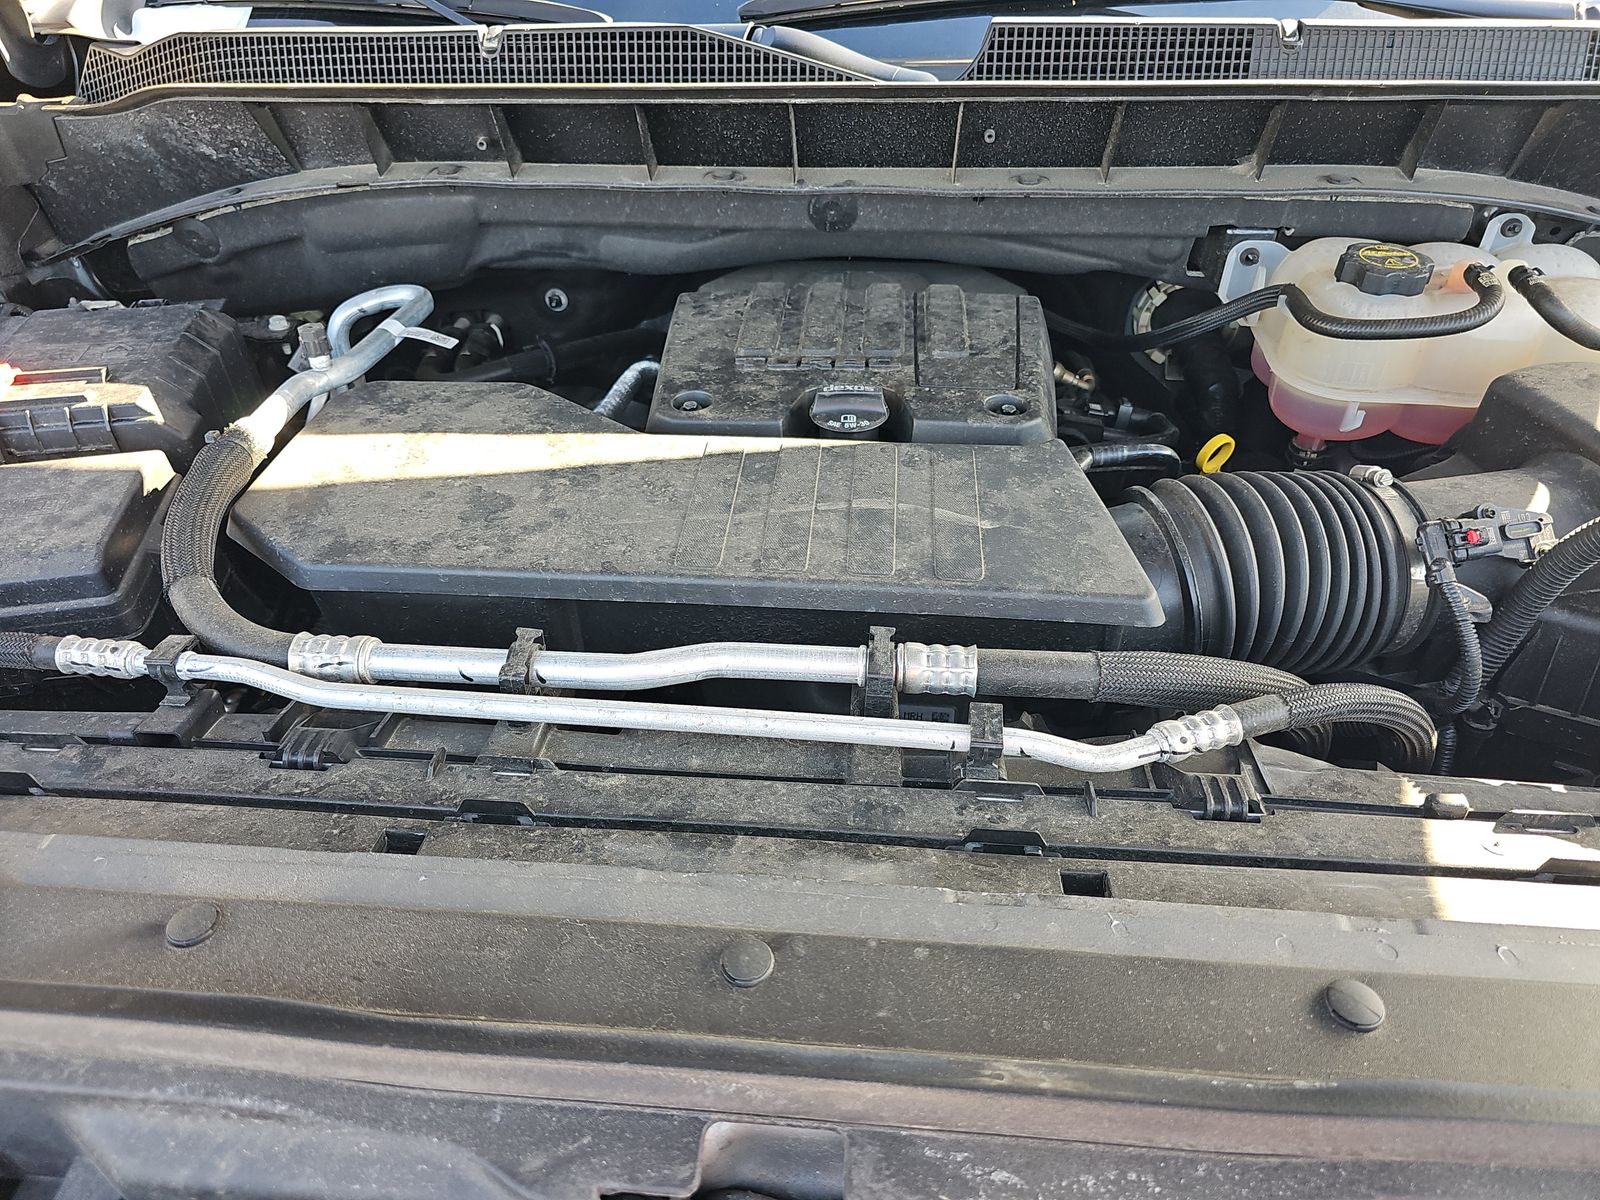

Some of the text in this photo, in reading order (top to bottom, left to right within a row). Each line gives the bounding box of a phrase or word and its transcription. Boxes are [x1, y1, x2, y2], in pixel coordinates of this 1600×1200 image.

[823, 384, 874, 392] dexos
[827, 420, 870, 428] SAE 5W-30
